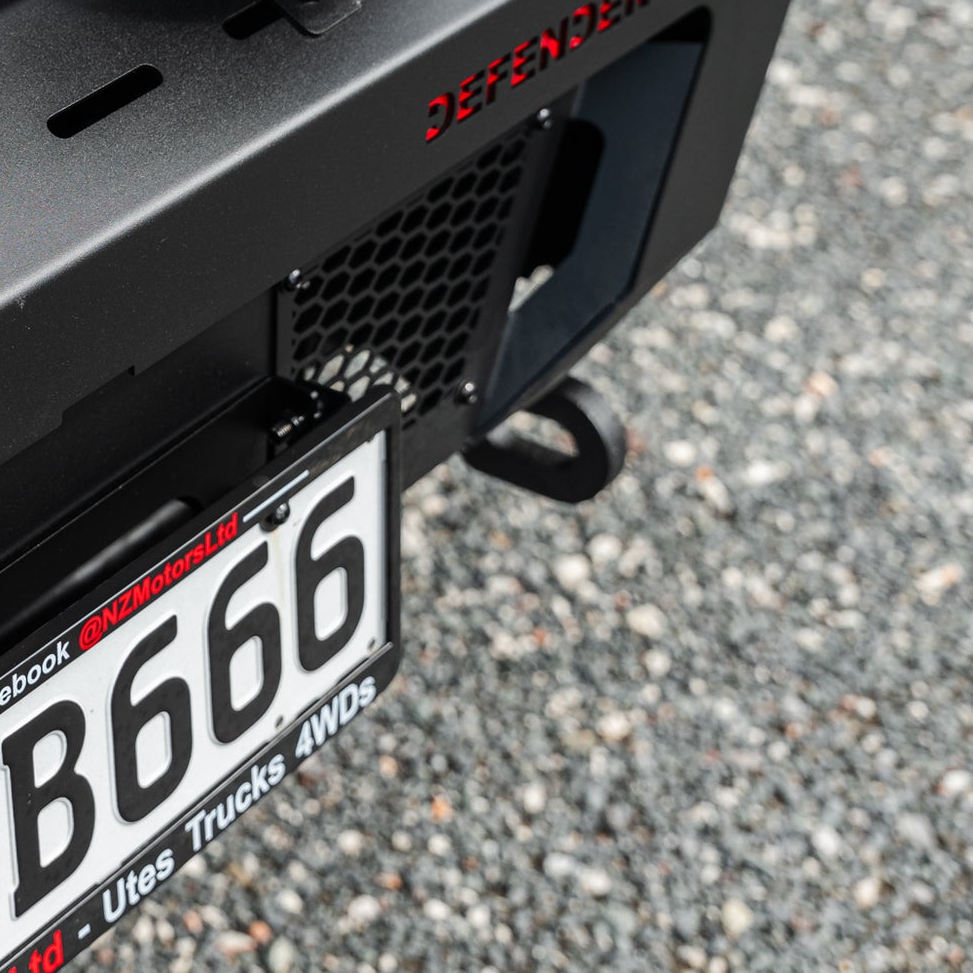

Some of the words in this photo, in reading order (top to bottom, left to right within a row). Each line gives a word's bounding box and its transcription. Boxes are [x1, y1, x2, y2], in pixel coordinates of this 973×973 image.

[78, 512, 239, 652] @NZMotorsLtd
[7, 929, 65, 973] td
[102, 847, 175, 923] Utes
[184, 753, 287, 852] Trucks
[294, 676, 377, 759] 4WDs
